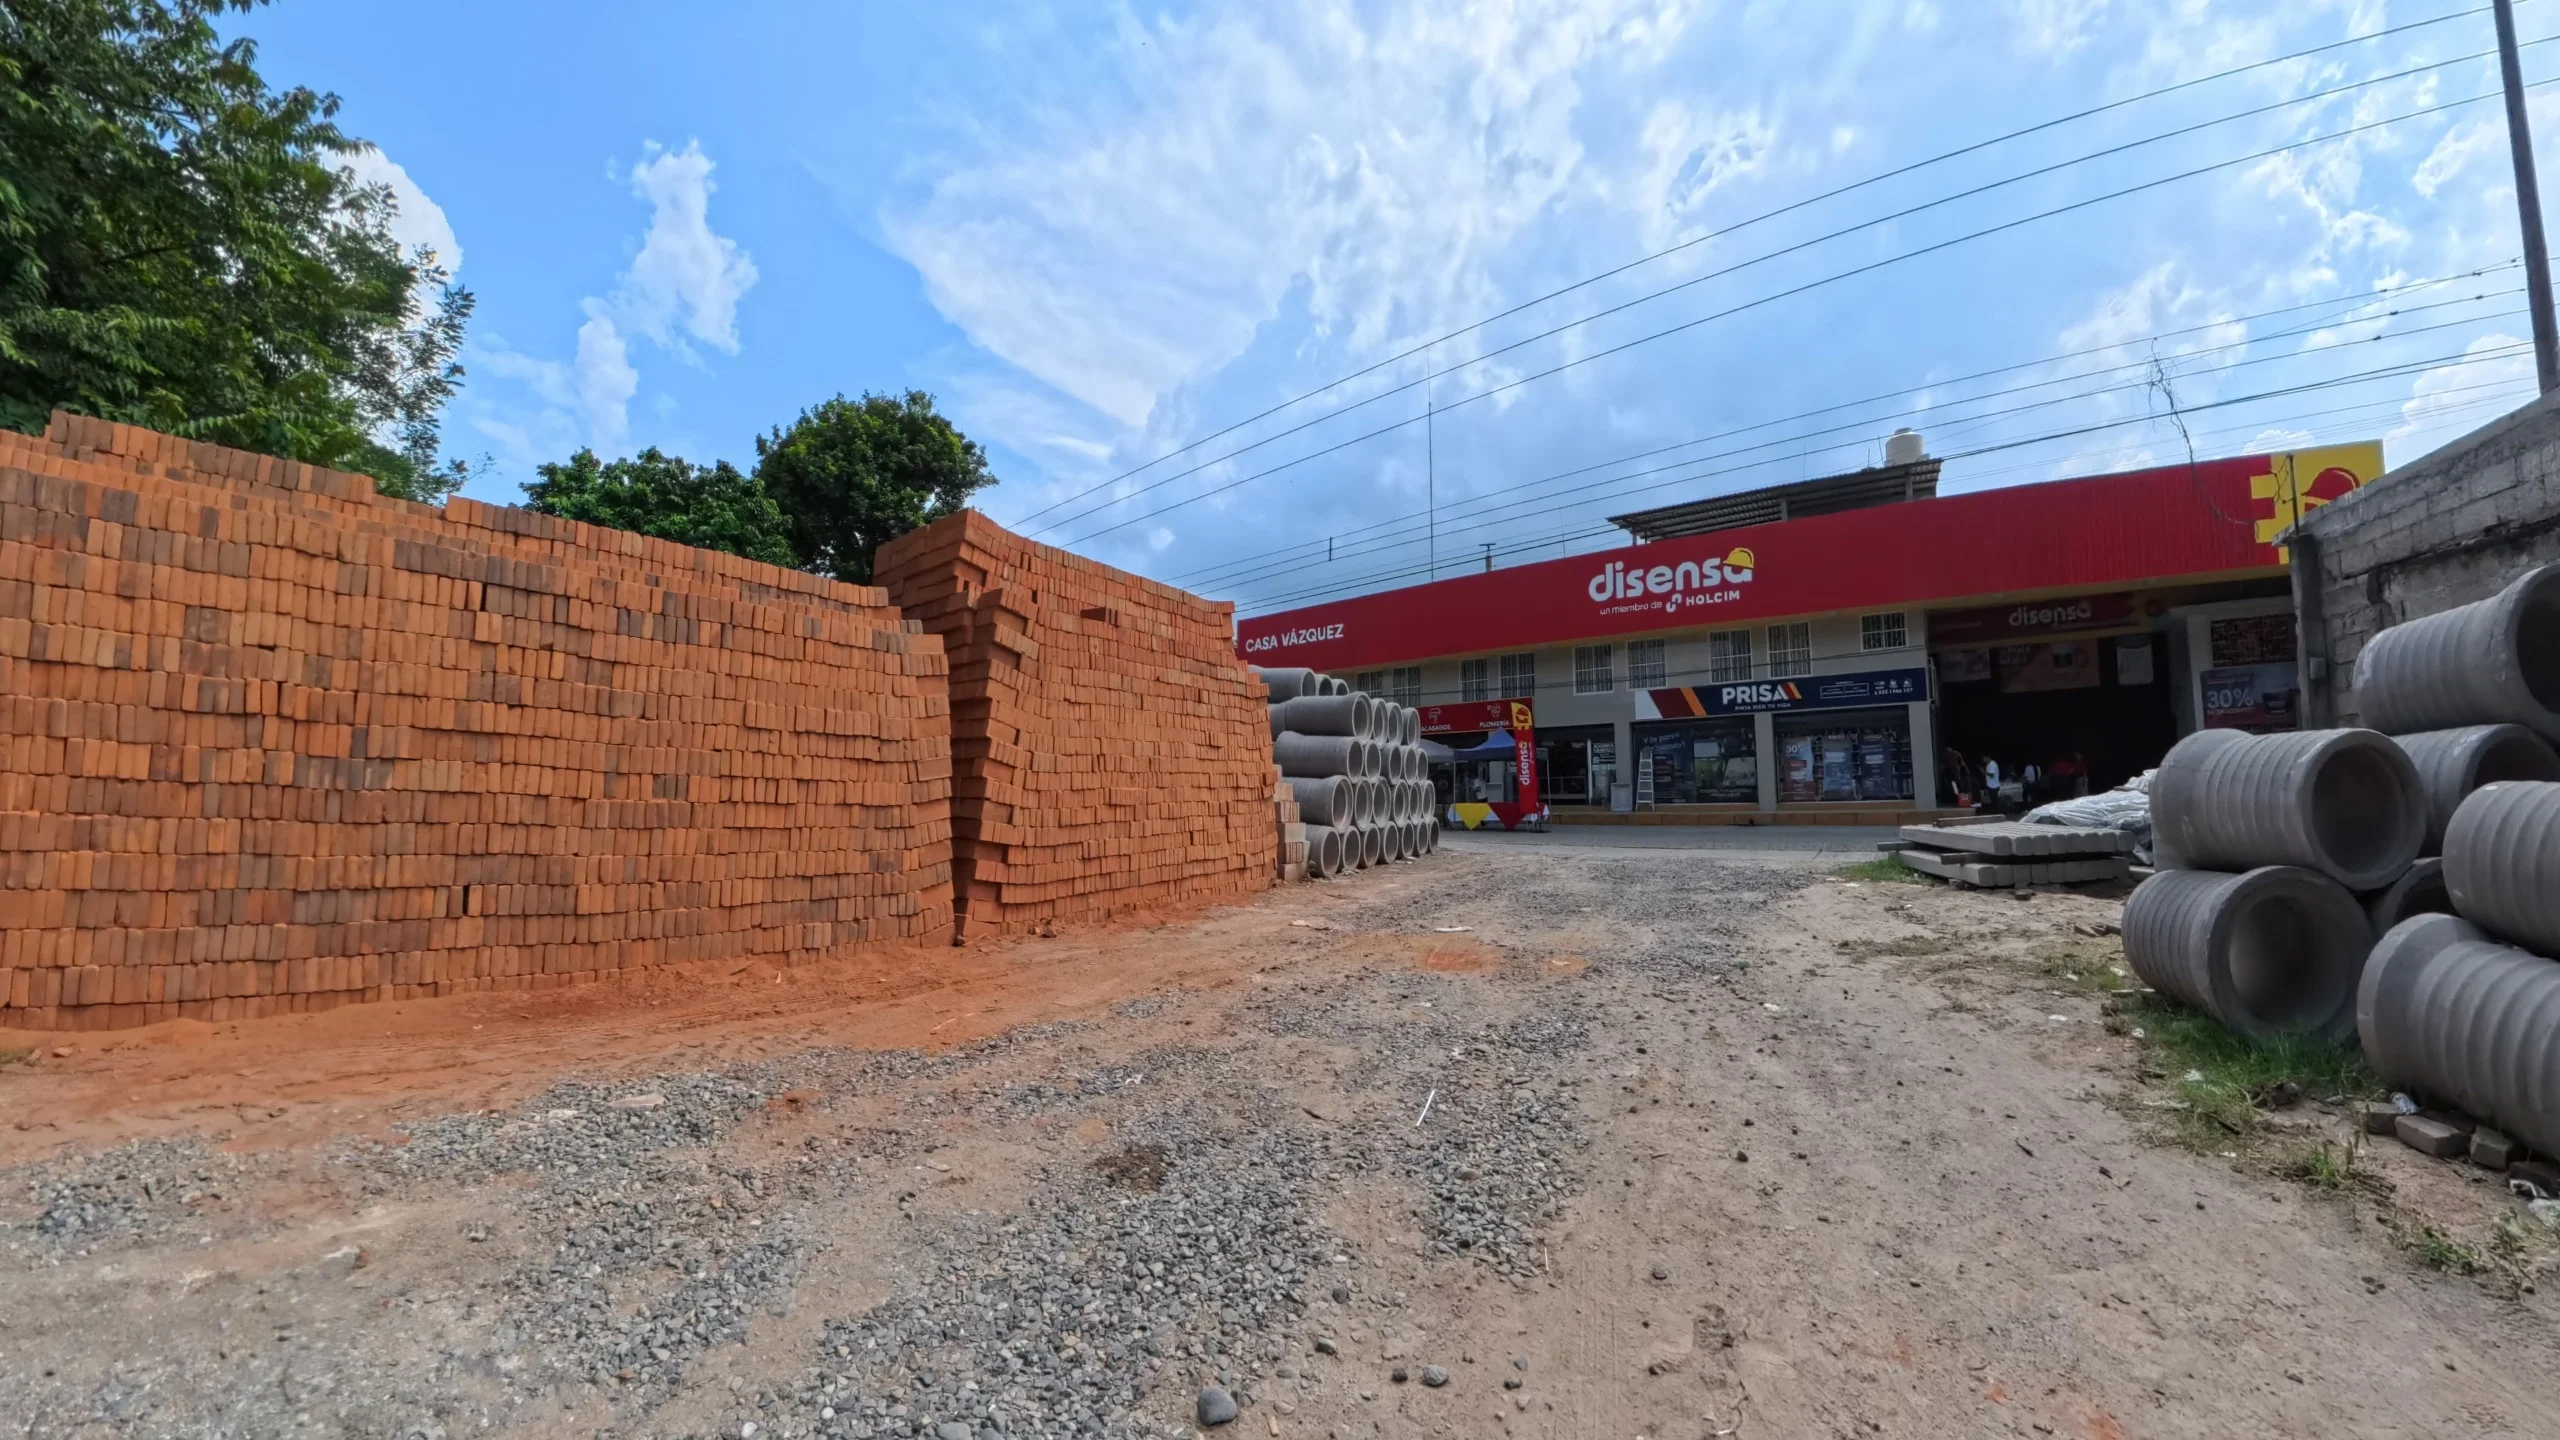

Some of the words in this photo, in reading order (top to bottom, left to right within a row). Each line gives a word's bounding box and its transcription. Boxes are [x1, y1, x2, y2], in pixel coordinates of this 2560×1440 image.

[1588, 557, 1753, 602] disensa
[1600, 607, 1611, 615] un
[1612, 603, 1649, 614] miembro
[1650, 601, 1662, 609] de
[1686, 590, 1740, 606] HOLCIM
[1245, 635, 1278, 652] CASA
[1281, 623, 1344, 647] VÁZQUEZ
[1722, 684, 1789, 705] PRISA
[2206, 687, 2255, 709] 30%
[1518, 741, 1530, 785] disensa
